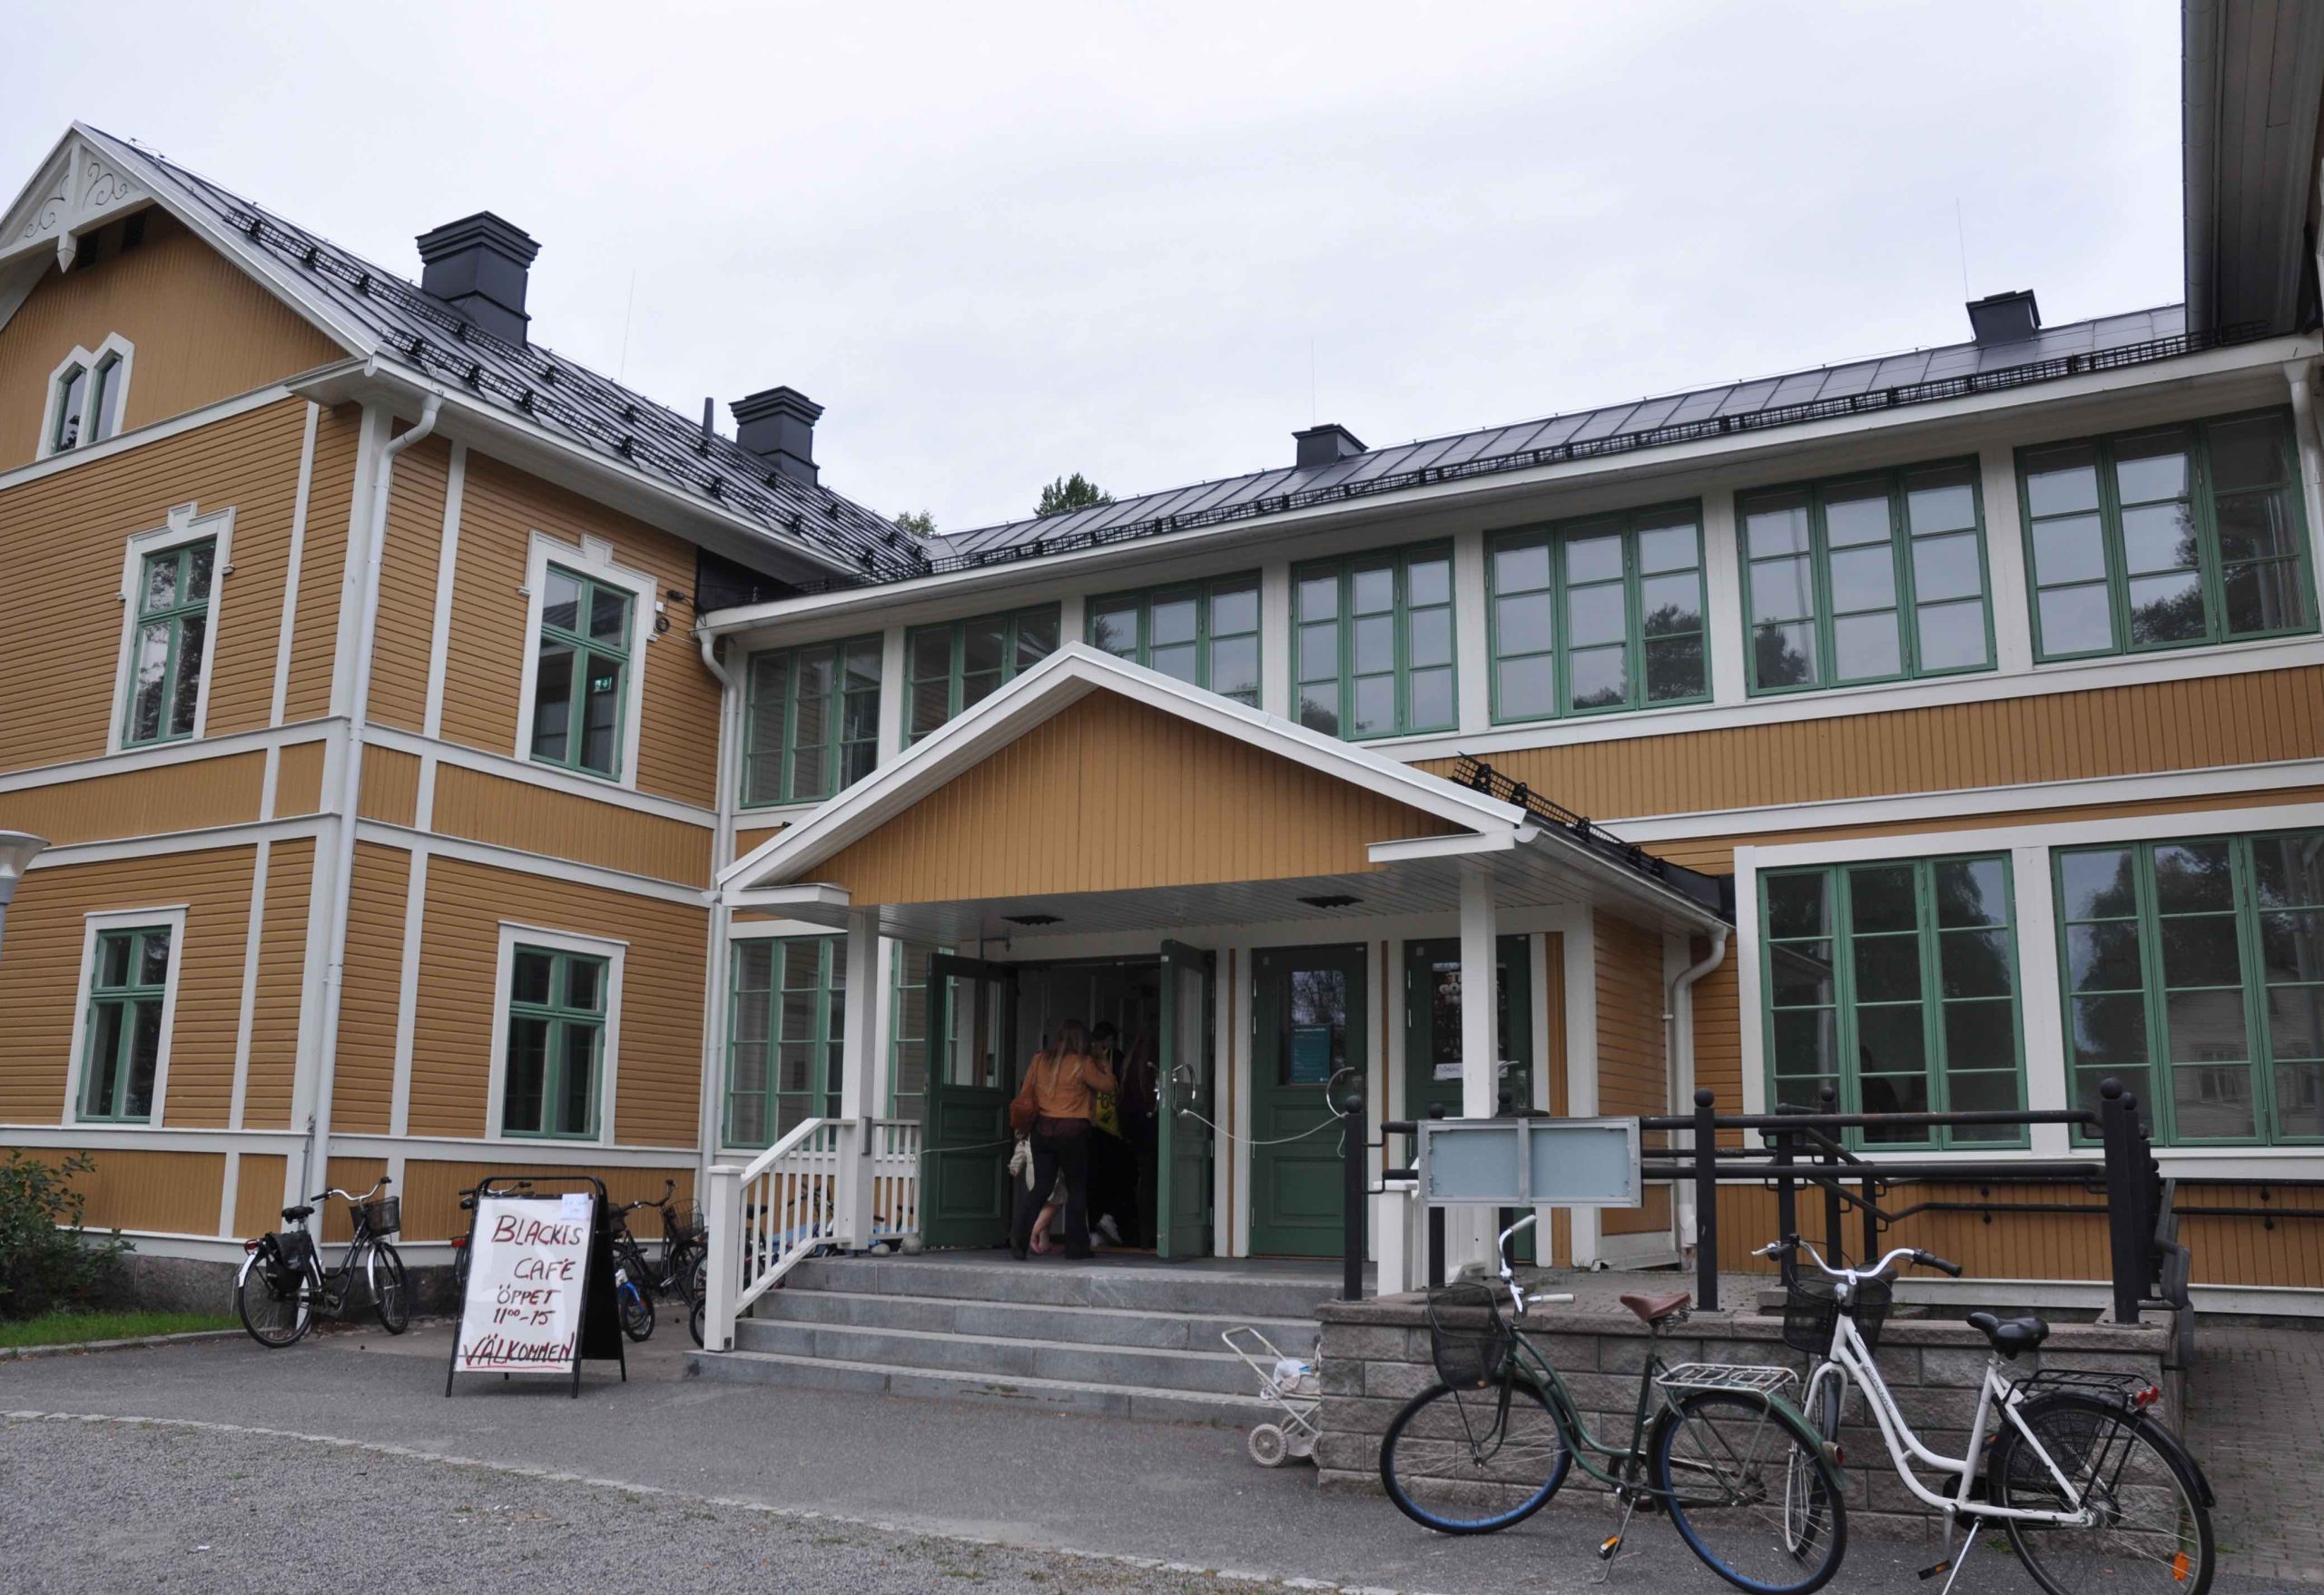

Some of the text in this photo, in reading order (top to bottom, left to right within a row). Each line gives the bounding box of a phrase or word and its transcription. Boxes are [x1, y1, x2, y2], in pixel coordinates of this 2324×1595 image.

[491, 1215, 584, 1246] BLACKIS
[497, 1284, 562, 1305] ÖPPET
[463, 1331, 576, 1366] VÄLKOMMEN
